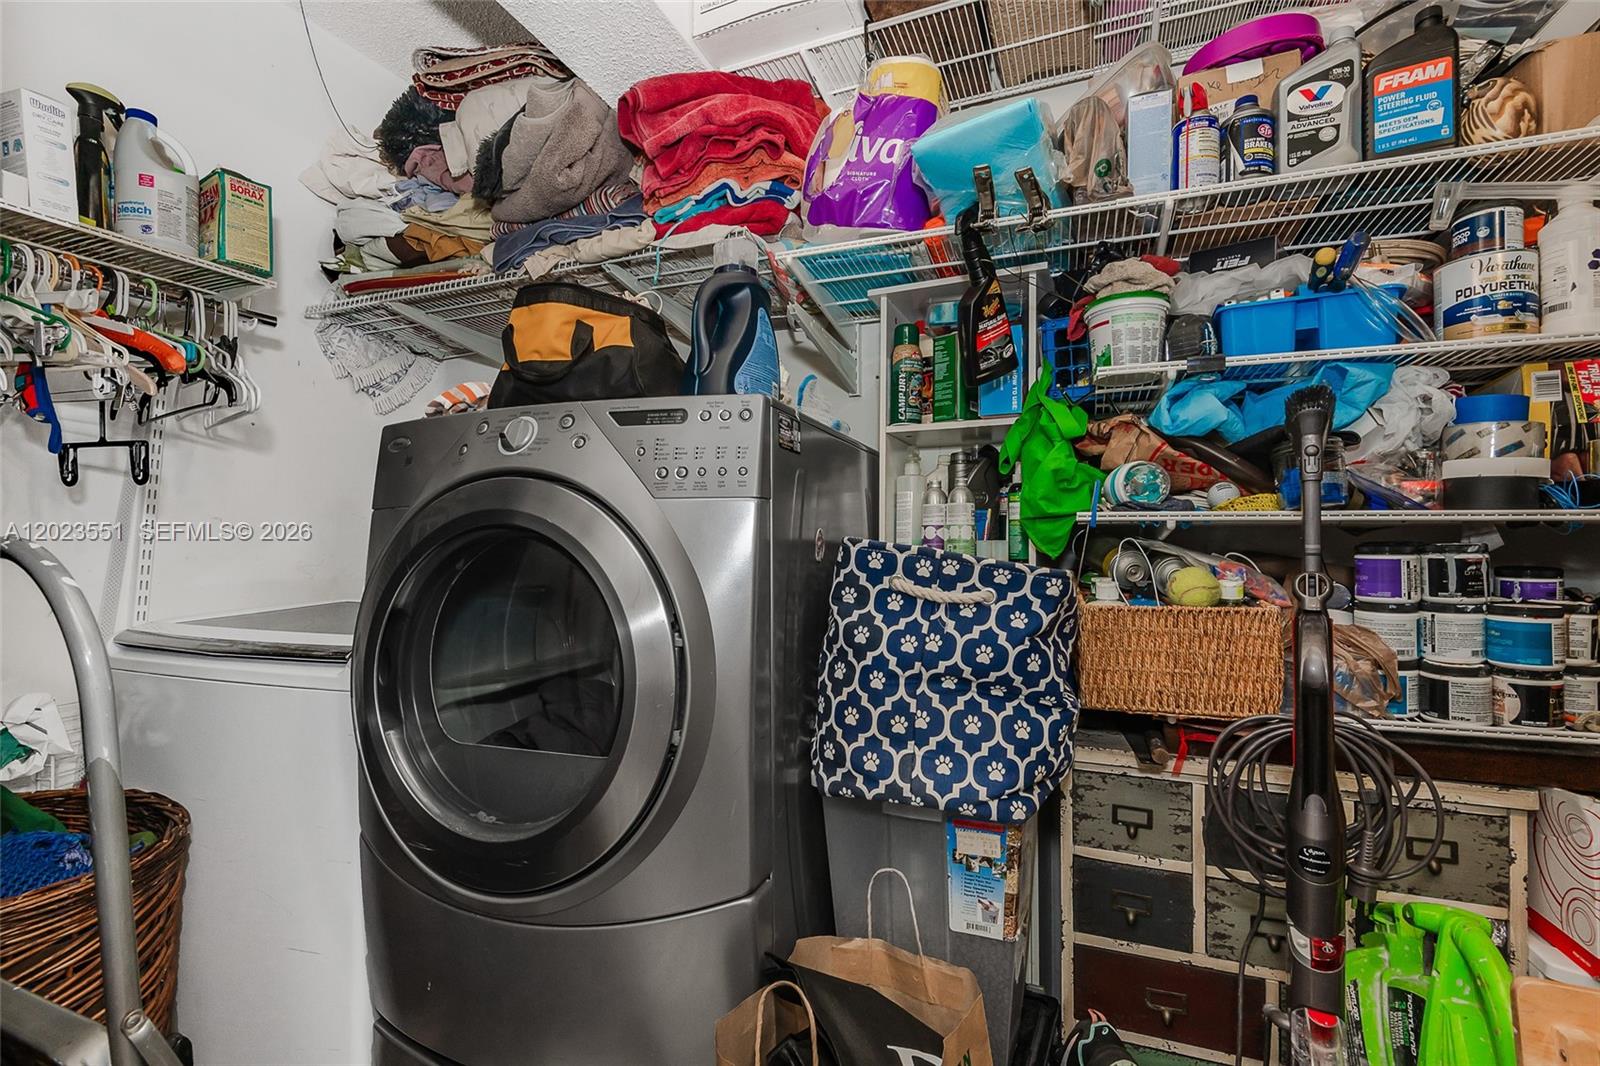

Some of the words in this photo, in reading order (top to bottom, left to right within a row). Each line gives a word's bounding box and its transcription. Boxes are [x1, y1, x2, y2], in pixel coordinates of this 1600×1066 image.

[1377, 62, 1447, 91] FRAM
[1298, 101, 1333, 111] Valvoline
[1377, 91, 1406, 104] POWER
[1377, 98, 1414, 112] STEERING
[1415, 91, 1437, 103] FLUID
[1290, 117, 1335, 130] ADVANCED
[1378, 118, 1402, 129] MEETS
[1403, 115, 1419, 123] OEM
[1378, 118, 1435, 135] SPECIFICATIONS
[848, 120, 904, 164] iva
[230, 183, 265, 202] BORAX
[1212, 256, 1250, 271] FEIT
[1577, 370, 1593, 394] FLAPS
[1407, 994, 1417, 1056] PORTLAND
